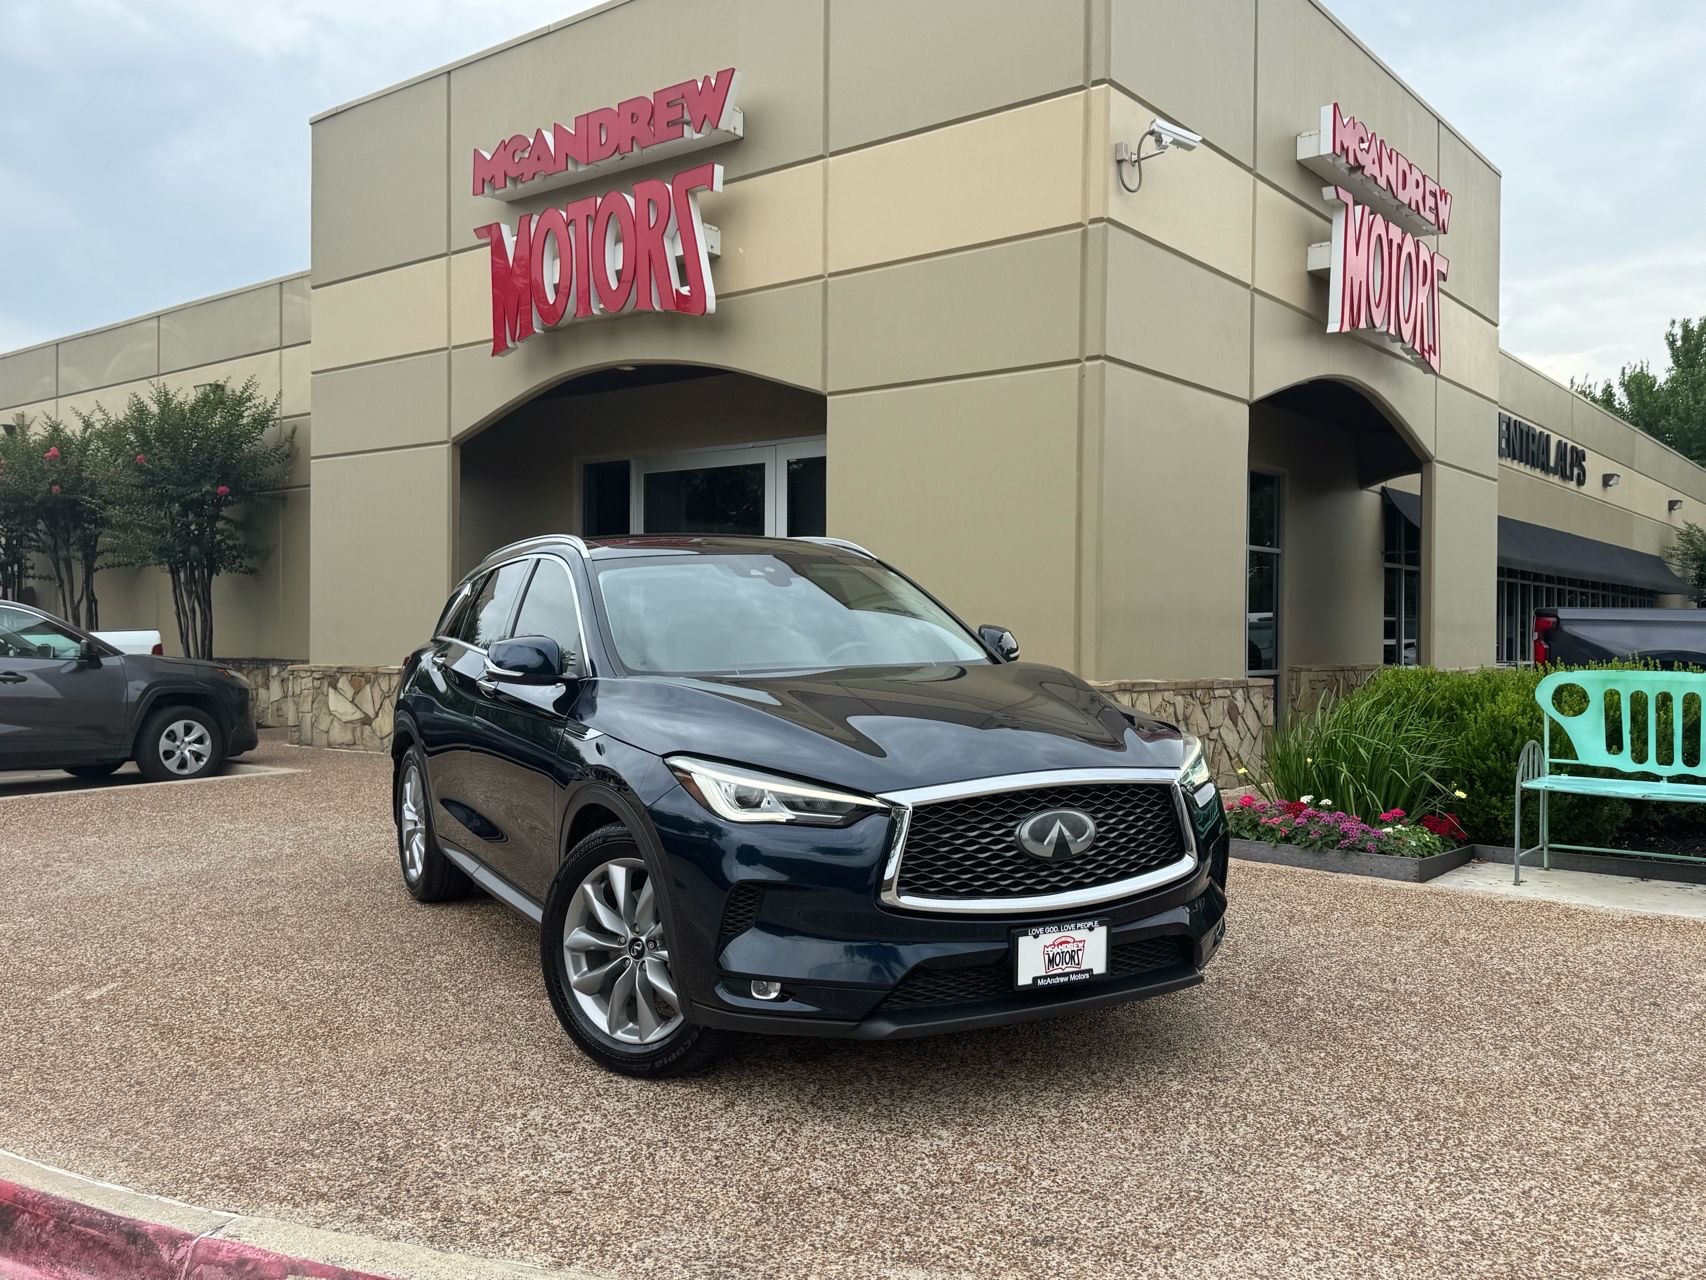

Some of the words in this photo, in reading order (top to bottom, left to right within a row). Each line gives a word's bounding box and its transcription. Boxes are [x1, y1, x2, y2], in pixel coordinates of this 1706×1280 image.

[473, 162, 717, 357] MOTORS
[1333, 185, 1450, 375] MOTORS
[1028, 927, 1044, 936] LOVE
[1044, 925, 1060, 934] GOD.
[1060, 923, 1076, 932] LOVE
[1076, 920, 1100, 930] PEOPLE.
[1045, 948, 1083, 971] MOTORS
[1037, 975, 1069, 986] McAndrew
[1069, 972, 1090, 982] Motors
